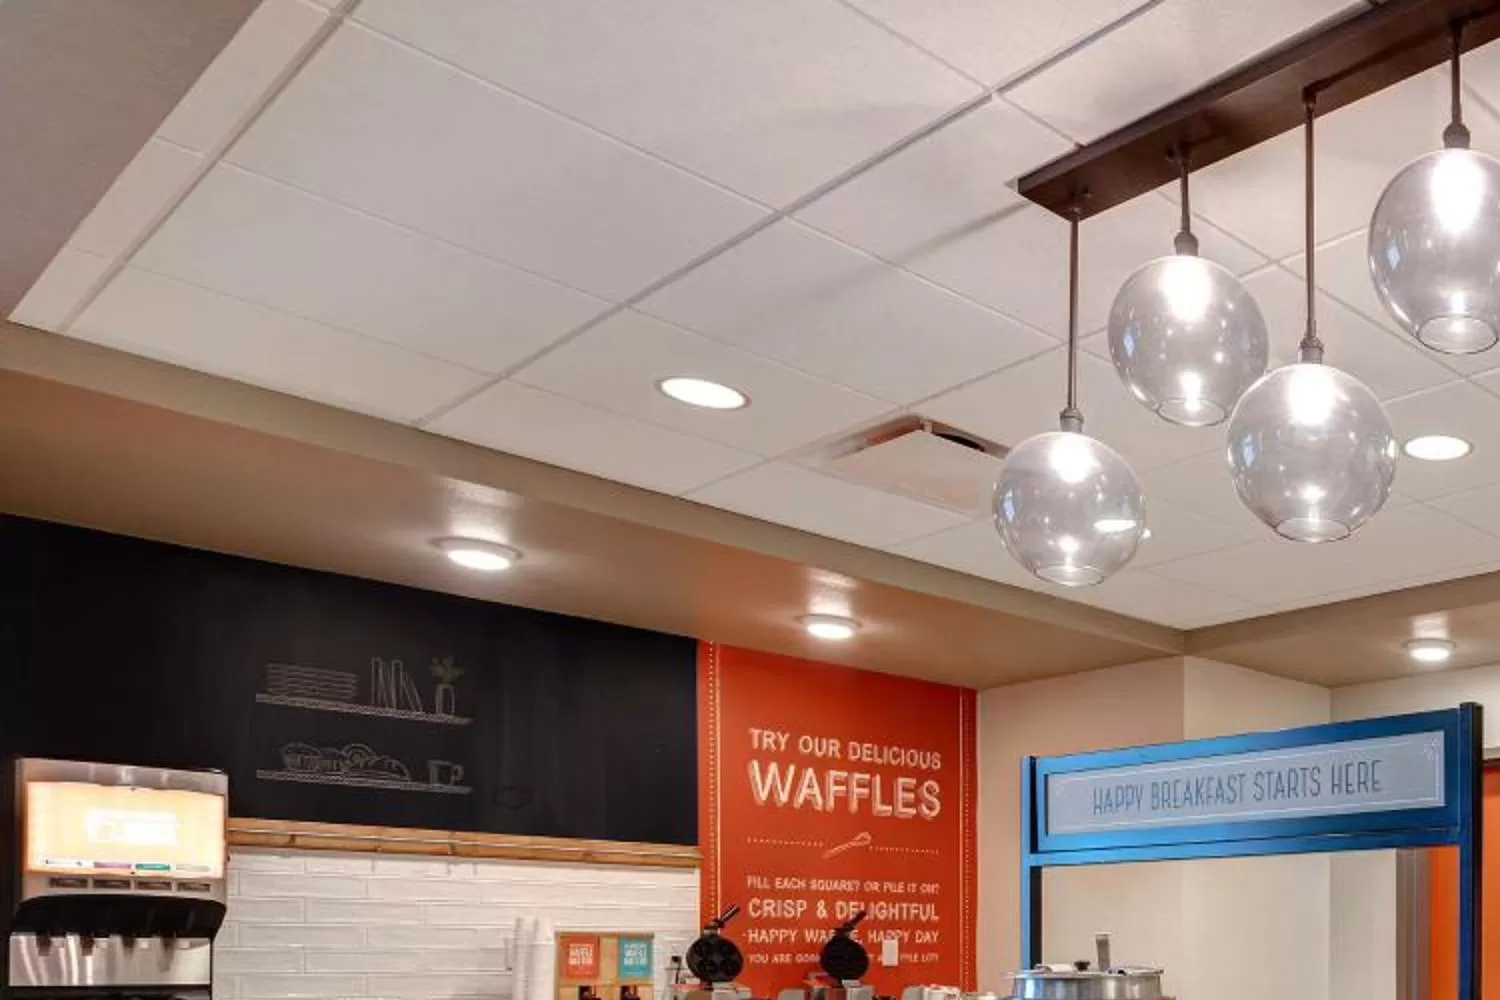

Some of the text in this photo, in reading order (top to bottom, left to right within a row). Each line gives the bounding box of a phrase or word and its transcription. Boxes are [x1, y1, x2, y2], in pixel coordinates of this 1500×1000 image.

[748, 727, 942, 770] TRY OUR DELICIOUS
[748, 759, 941, 820] WAFFLES
[1092, 760, 1383, 816] HAPPY BREAKFAST STARTS HERE
[747, 875, 771, 889] FILL
[863, 880, 880, 893] OR
[882, 881, 905, 893] PILE
[748, 897, 939, 922] CRISP & DELIGHTFUL
[747, 928, 798, 944] HAPPY
[867, 929, 911, 944] HAPPY
[915, 929, 940, 944] DAY
